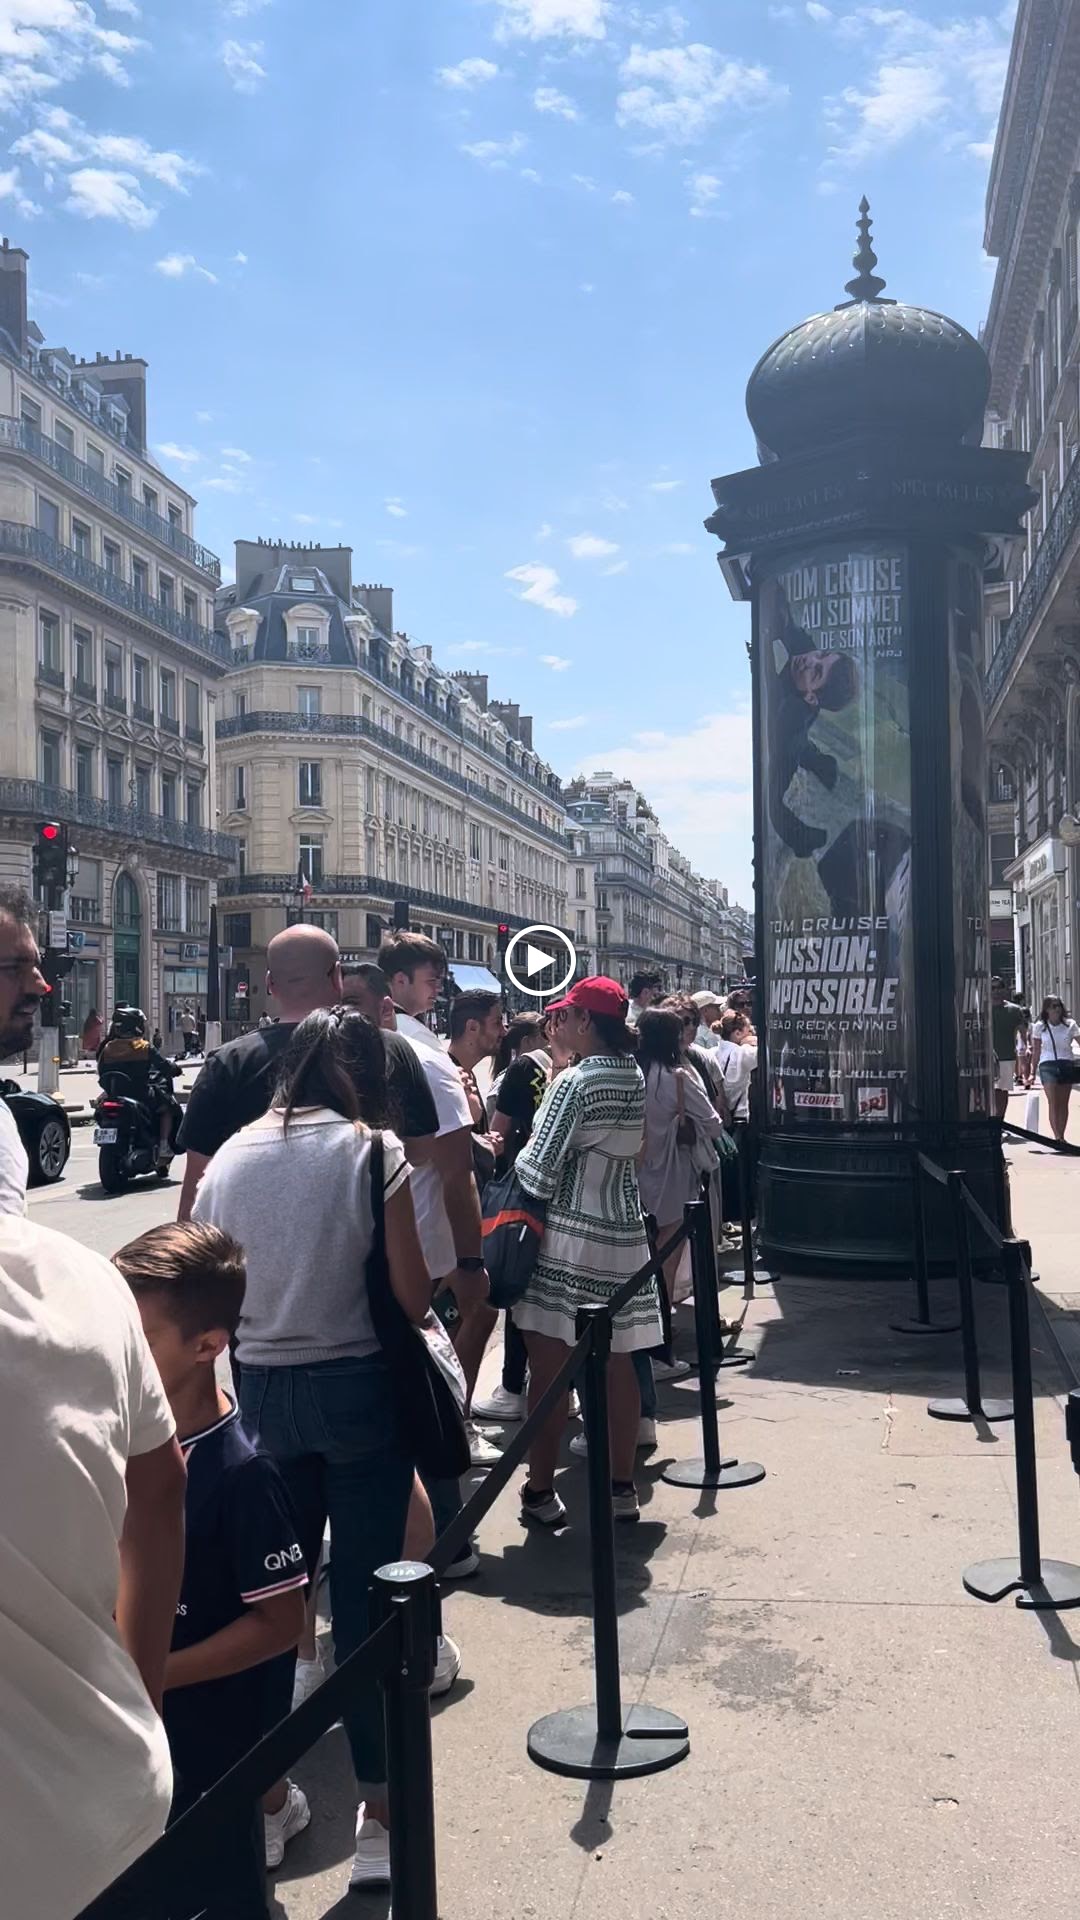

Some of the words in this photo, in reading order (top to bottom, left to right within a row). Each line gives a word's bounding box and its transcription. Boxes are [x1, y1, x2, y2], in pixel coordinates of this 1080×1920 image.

[825, 558, 902, 596] CRUISE
[801, 601, 821, 629] AU
[827, 595, 901, 626] SOMMET
[820, 631, 836, 650] DE
[840, 626, 865, 649] SON
[769, 920, 794, 933] TOM
[802, 916, 889, 931] CRUISE
[774, 936, 877, 973] MISSION:
[796, 1020, 898, 1031] RECKONING
[809, 1069, 824, 1078] LE
[845, 1070, 907, 1079] JUILLET
[264, 1543, 303, 1571] QNB
